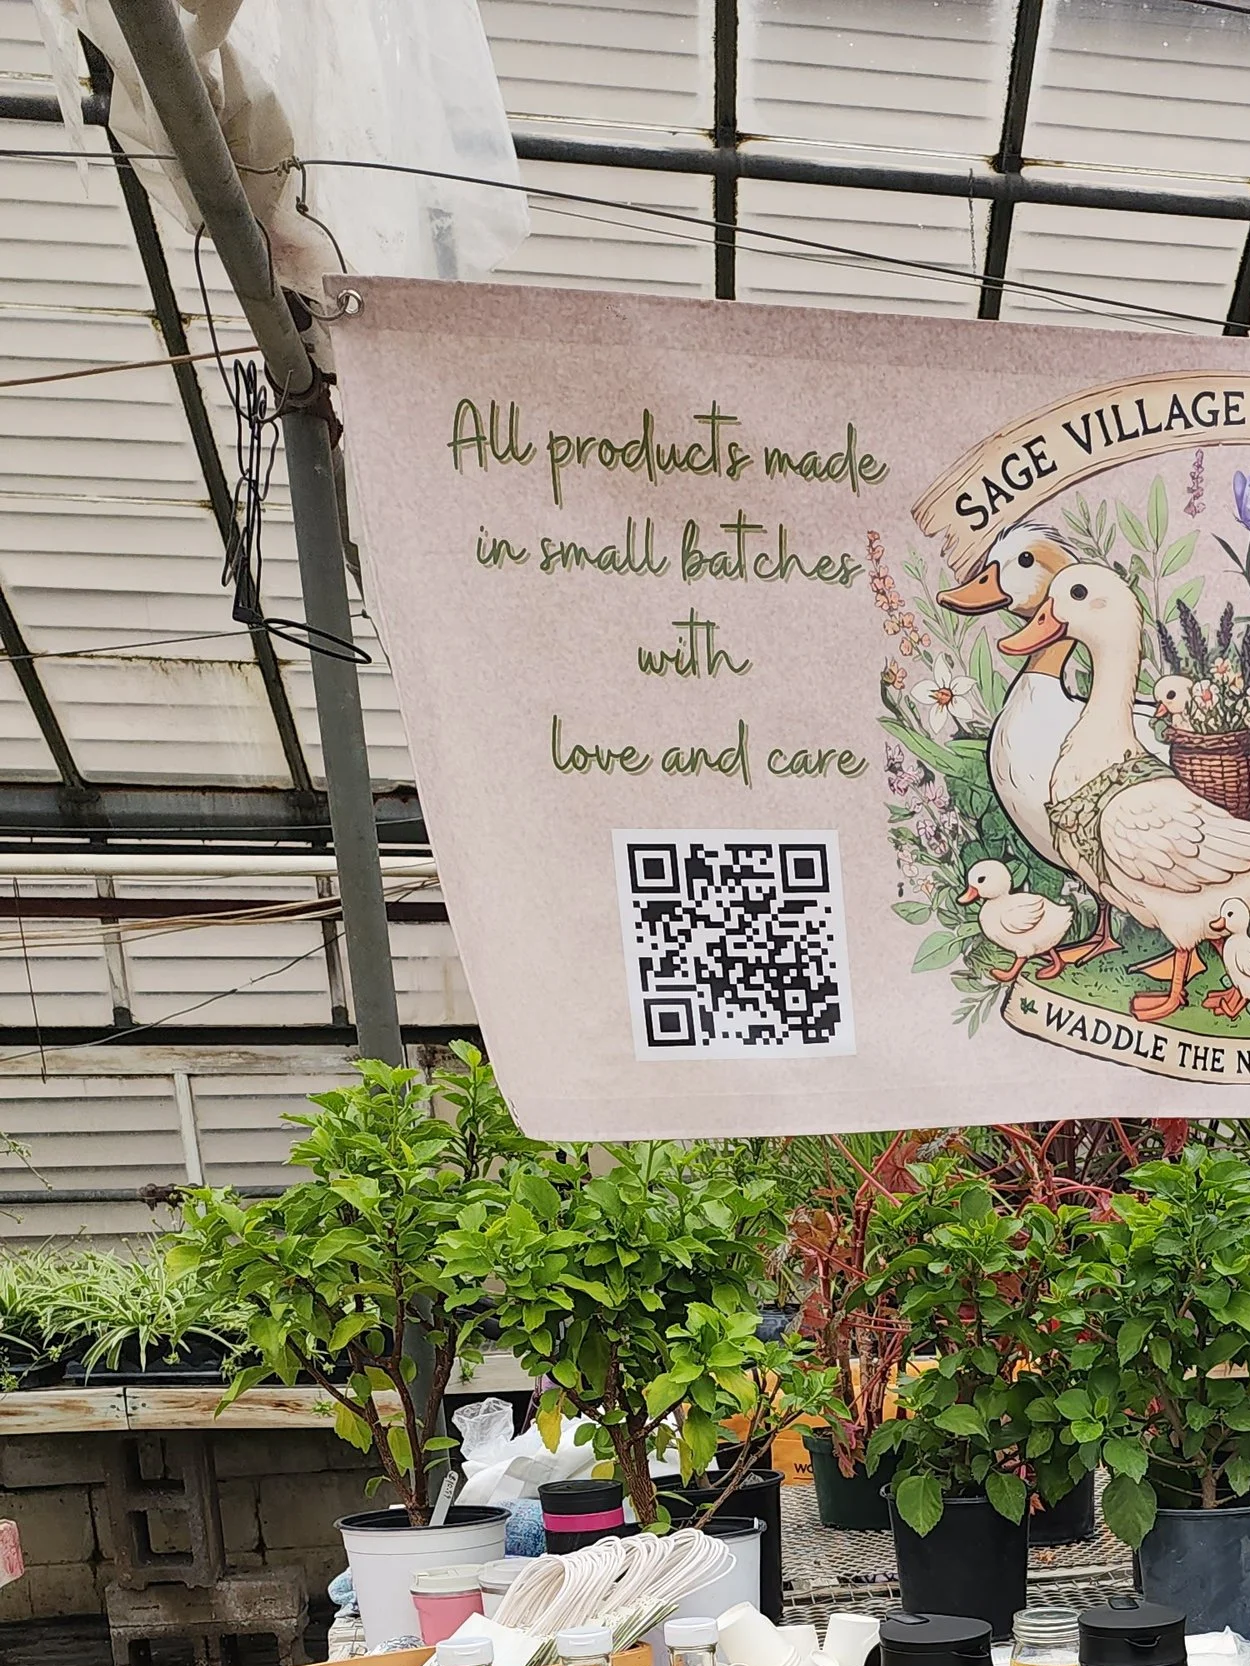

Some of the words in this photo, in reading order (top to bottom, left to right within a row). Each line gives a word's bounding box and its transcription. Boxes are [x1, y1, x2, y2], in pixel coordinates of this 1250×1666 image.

[448, 399, 533, 472] All
[548, 401, 753, 506] products
[763, 423, 890, 494] made
[954, 442, 1058, 532] SAGE
[1062, 390, 1247, 459] VILLAGE
[476, 526, 530, 568] in
[539, 518, 668, 577] small
[681, 509, 866, 586] batches
[637, 607, 752, 679] with
[551, 715, 652, 777] love
[661, 718, 752, 790] and
[767, 745, 868, 779] care
[1043, 998, 1170, 1065] WADDLE
[1177, 1041, 1226, 1074] THE
